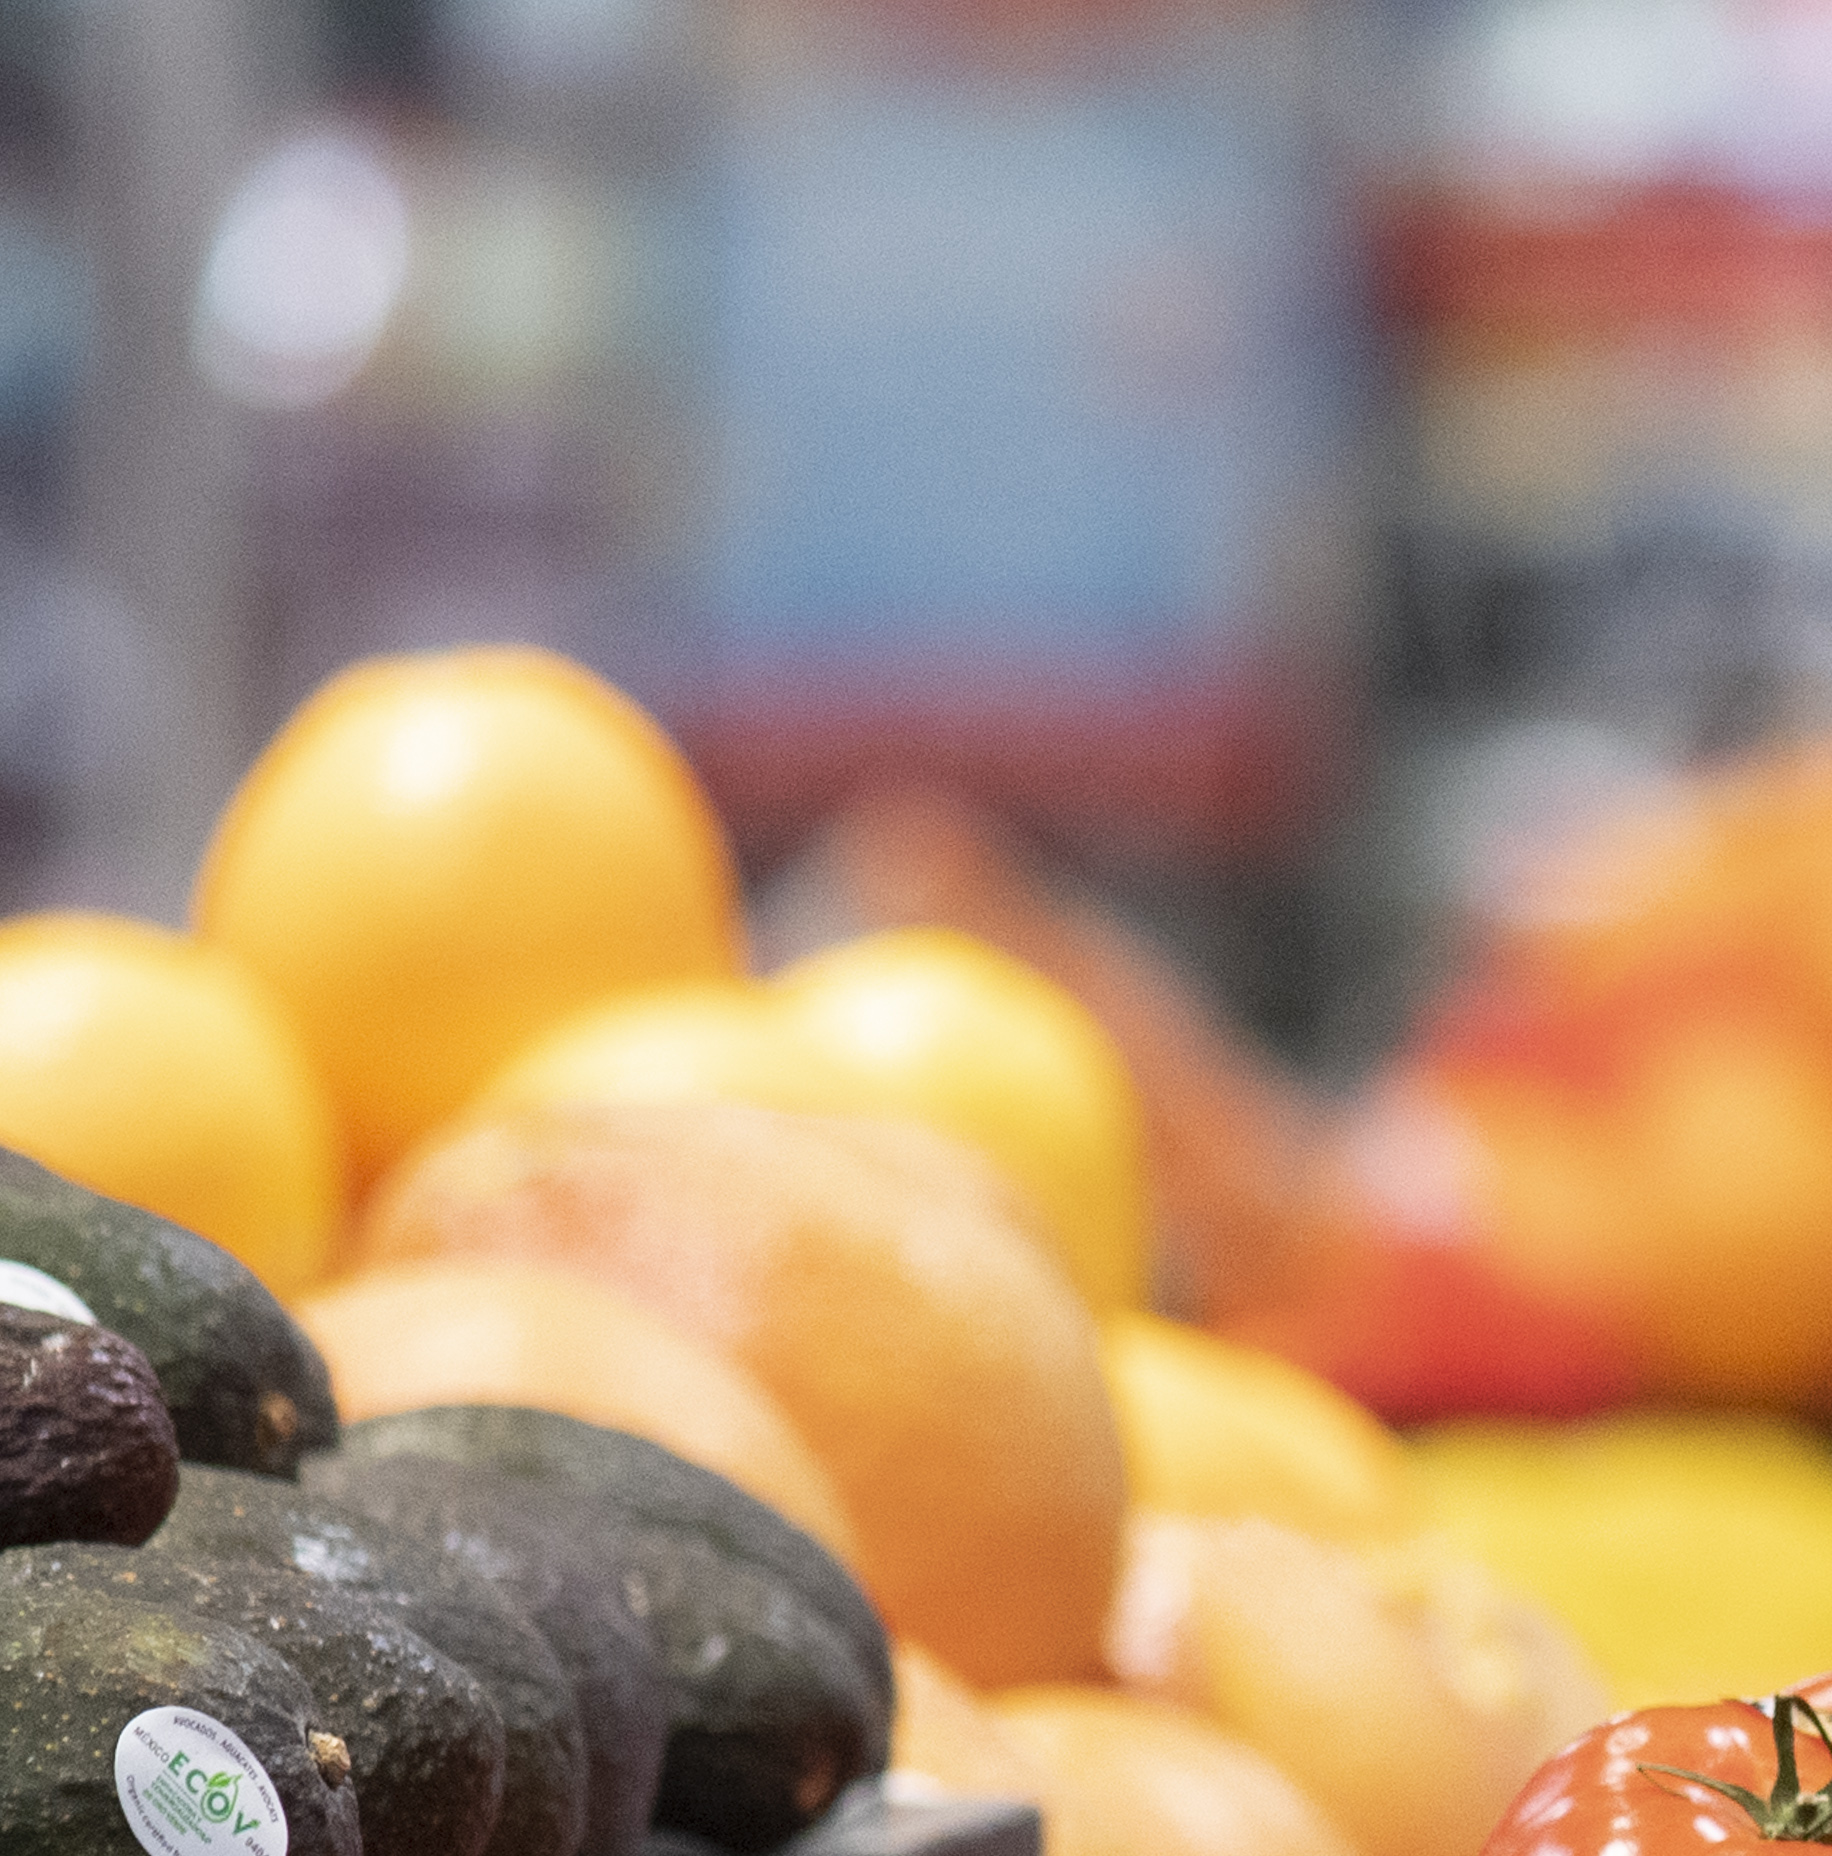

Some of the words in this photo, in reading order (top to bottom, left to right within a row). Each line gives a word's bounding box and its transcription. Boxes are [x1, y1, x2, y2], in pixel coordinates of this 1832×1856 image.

[133, 1726, 170, 1764] MÉXICO
[173, 1715, 217, 1741] AVOCADOS
[219, 1739, 258, 1780] AGUACATES
[258, 1785, 279, 1823] AVOCATS
[126, 1774, 145, 1820] Organic
[168, 1750, 261, 1836] ECOV
